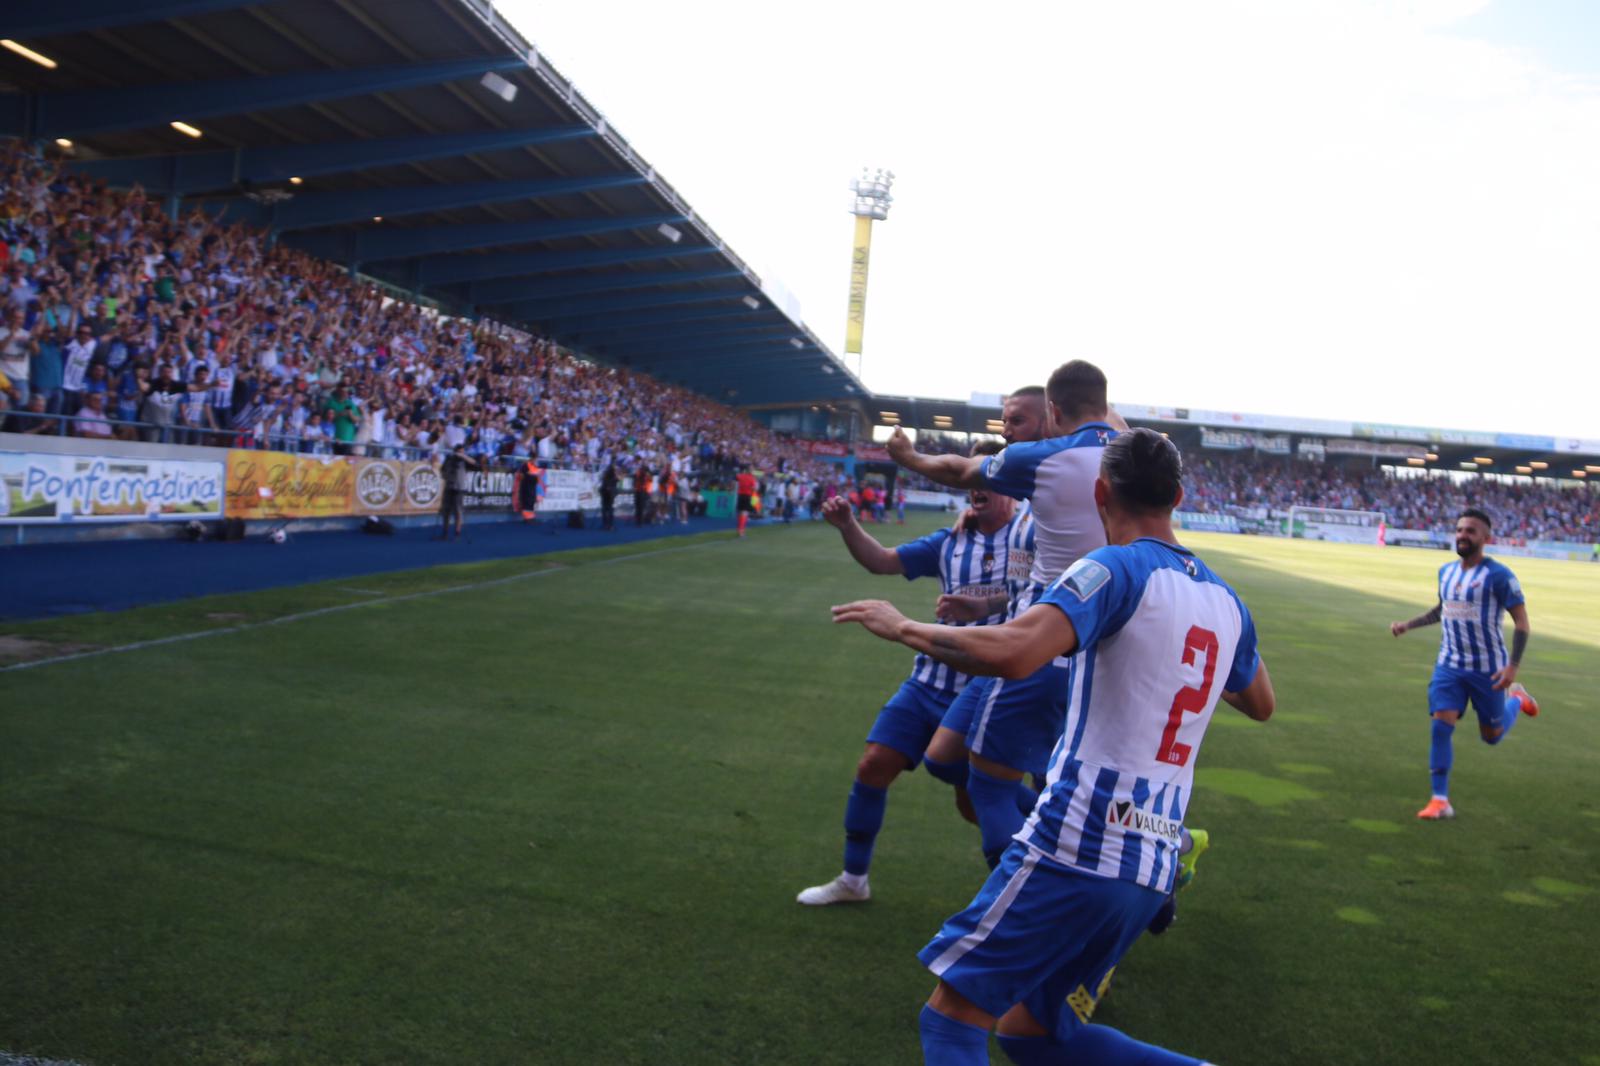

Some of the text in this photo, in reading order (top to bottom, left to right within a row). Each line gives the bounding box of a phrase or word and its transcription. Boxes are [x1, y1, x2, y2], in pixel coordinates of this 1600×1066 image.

[25, 461, 217, 509] Ponferradina
[1156, 624, 1219, 767] 2
[1136, 813, 1179, 839] VALCAR
